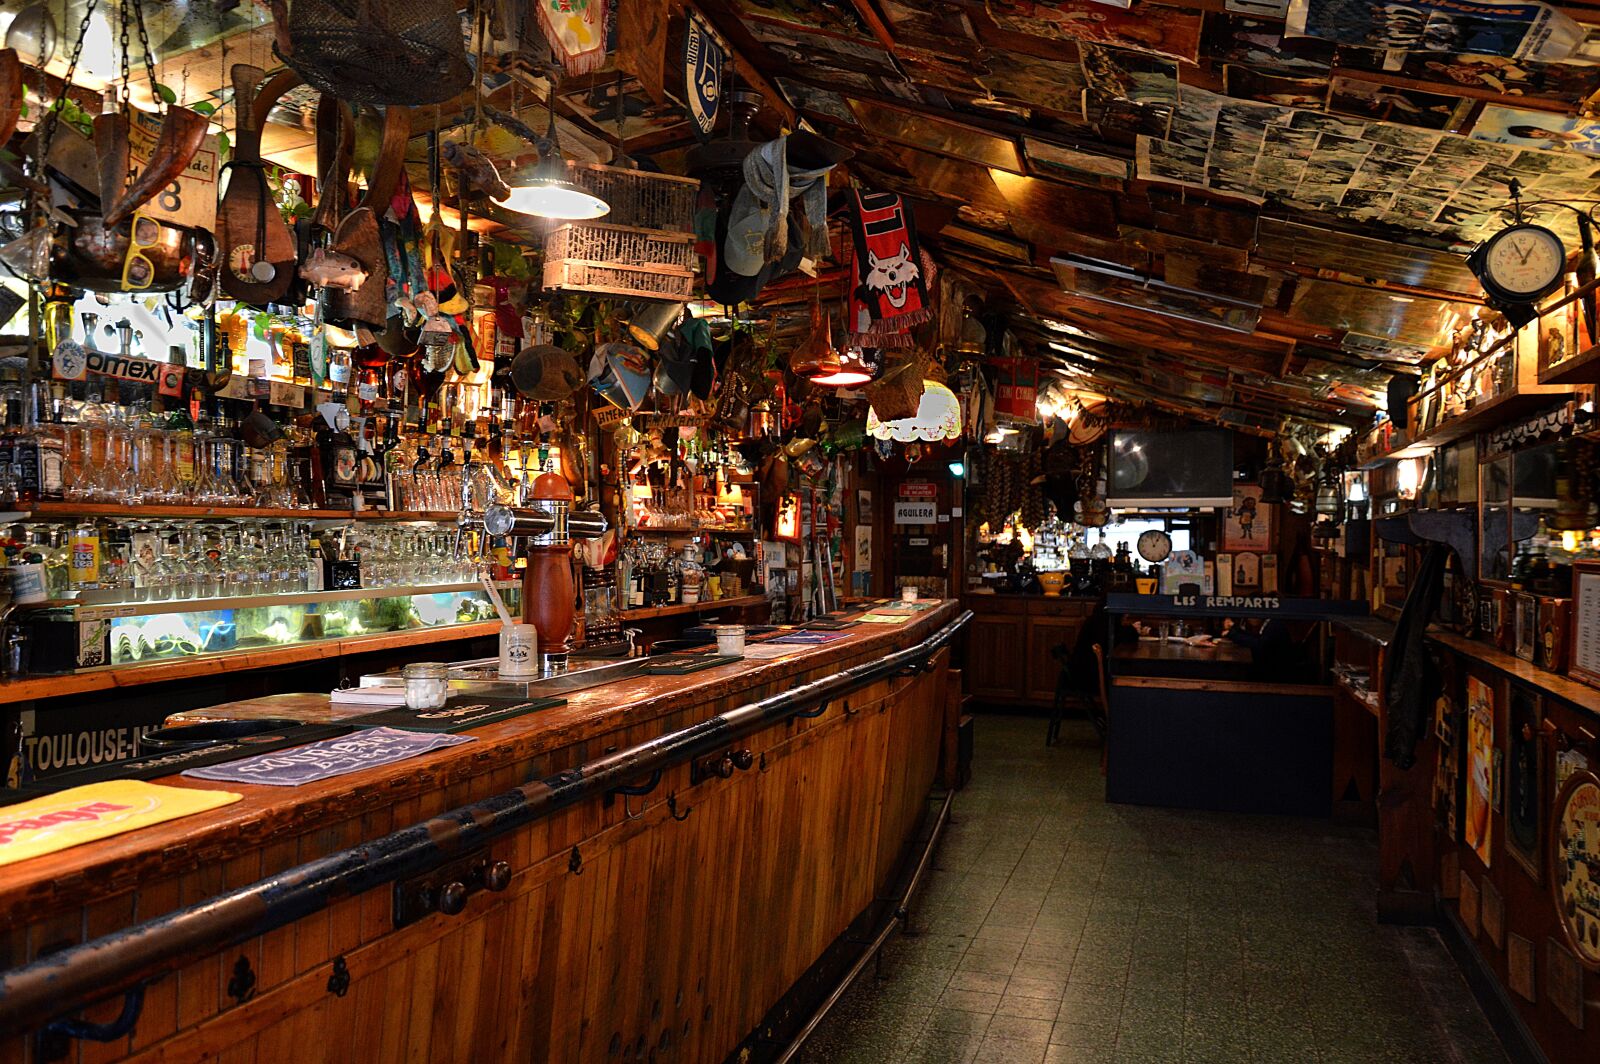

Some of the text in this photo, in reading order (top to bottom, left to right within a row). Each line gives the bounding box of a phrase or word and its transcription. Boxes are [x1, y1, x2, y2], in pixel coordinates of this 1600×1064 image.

[687, 28, 700, 66] RUGBY
[898, 508, 933, 518] AGUILERA
[73, 552, 94, 561] Ice
[1173, 595, 1280, 609] LES REMPARTS
[25, 725, 160, 772] TOULOUSE-M
